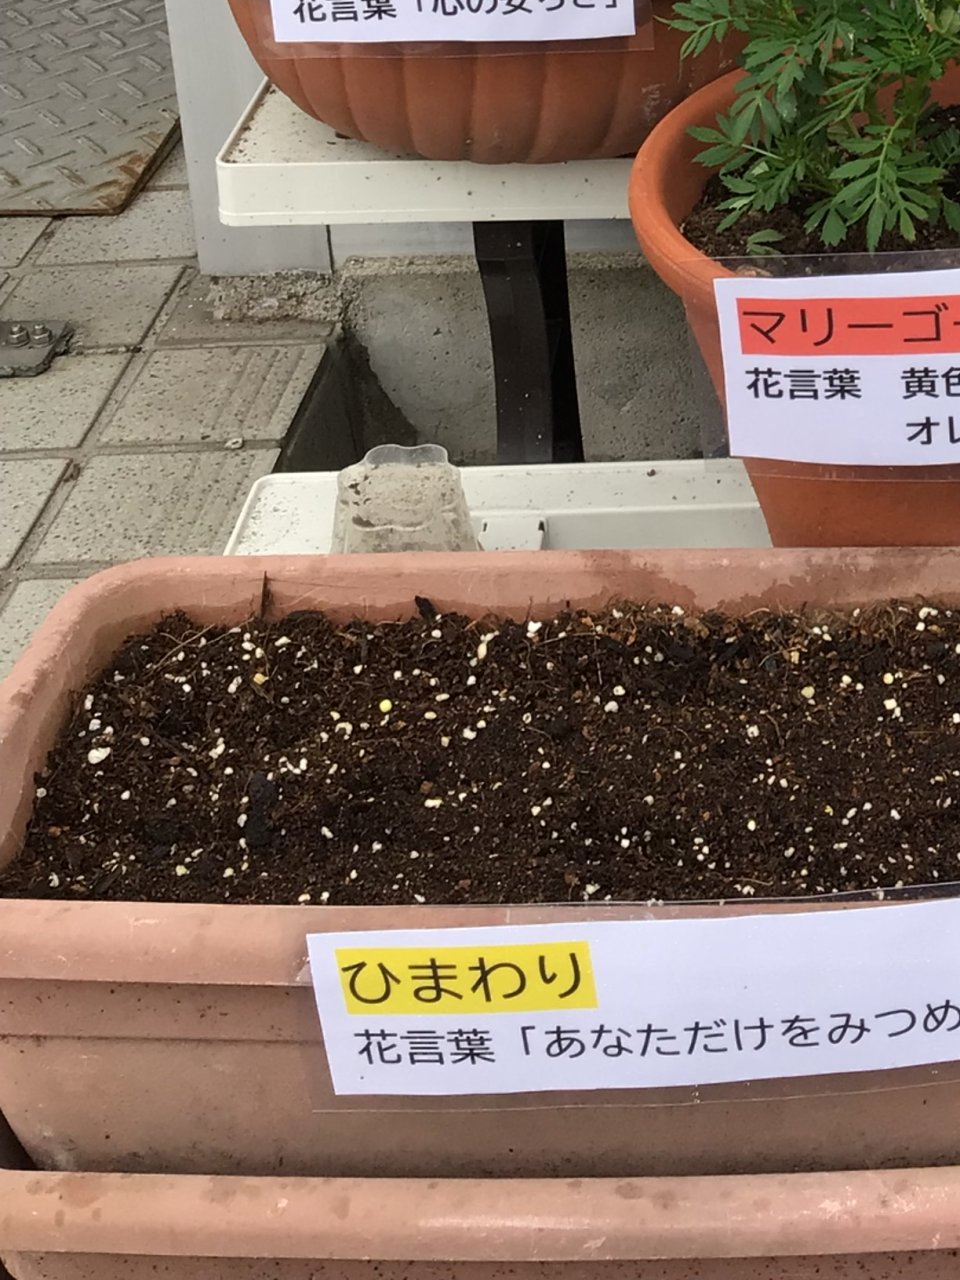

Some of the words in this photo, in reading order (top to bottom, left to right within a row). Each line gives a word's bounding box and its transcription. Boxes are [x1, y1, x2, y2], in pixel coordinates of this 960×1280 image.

[745, 367, 862, 400] 花言葉
[341, 950, 583, 1005] ひまわり
